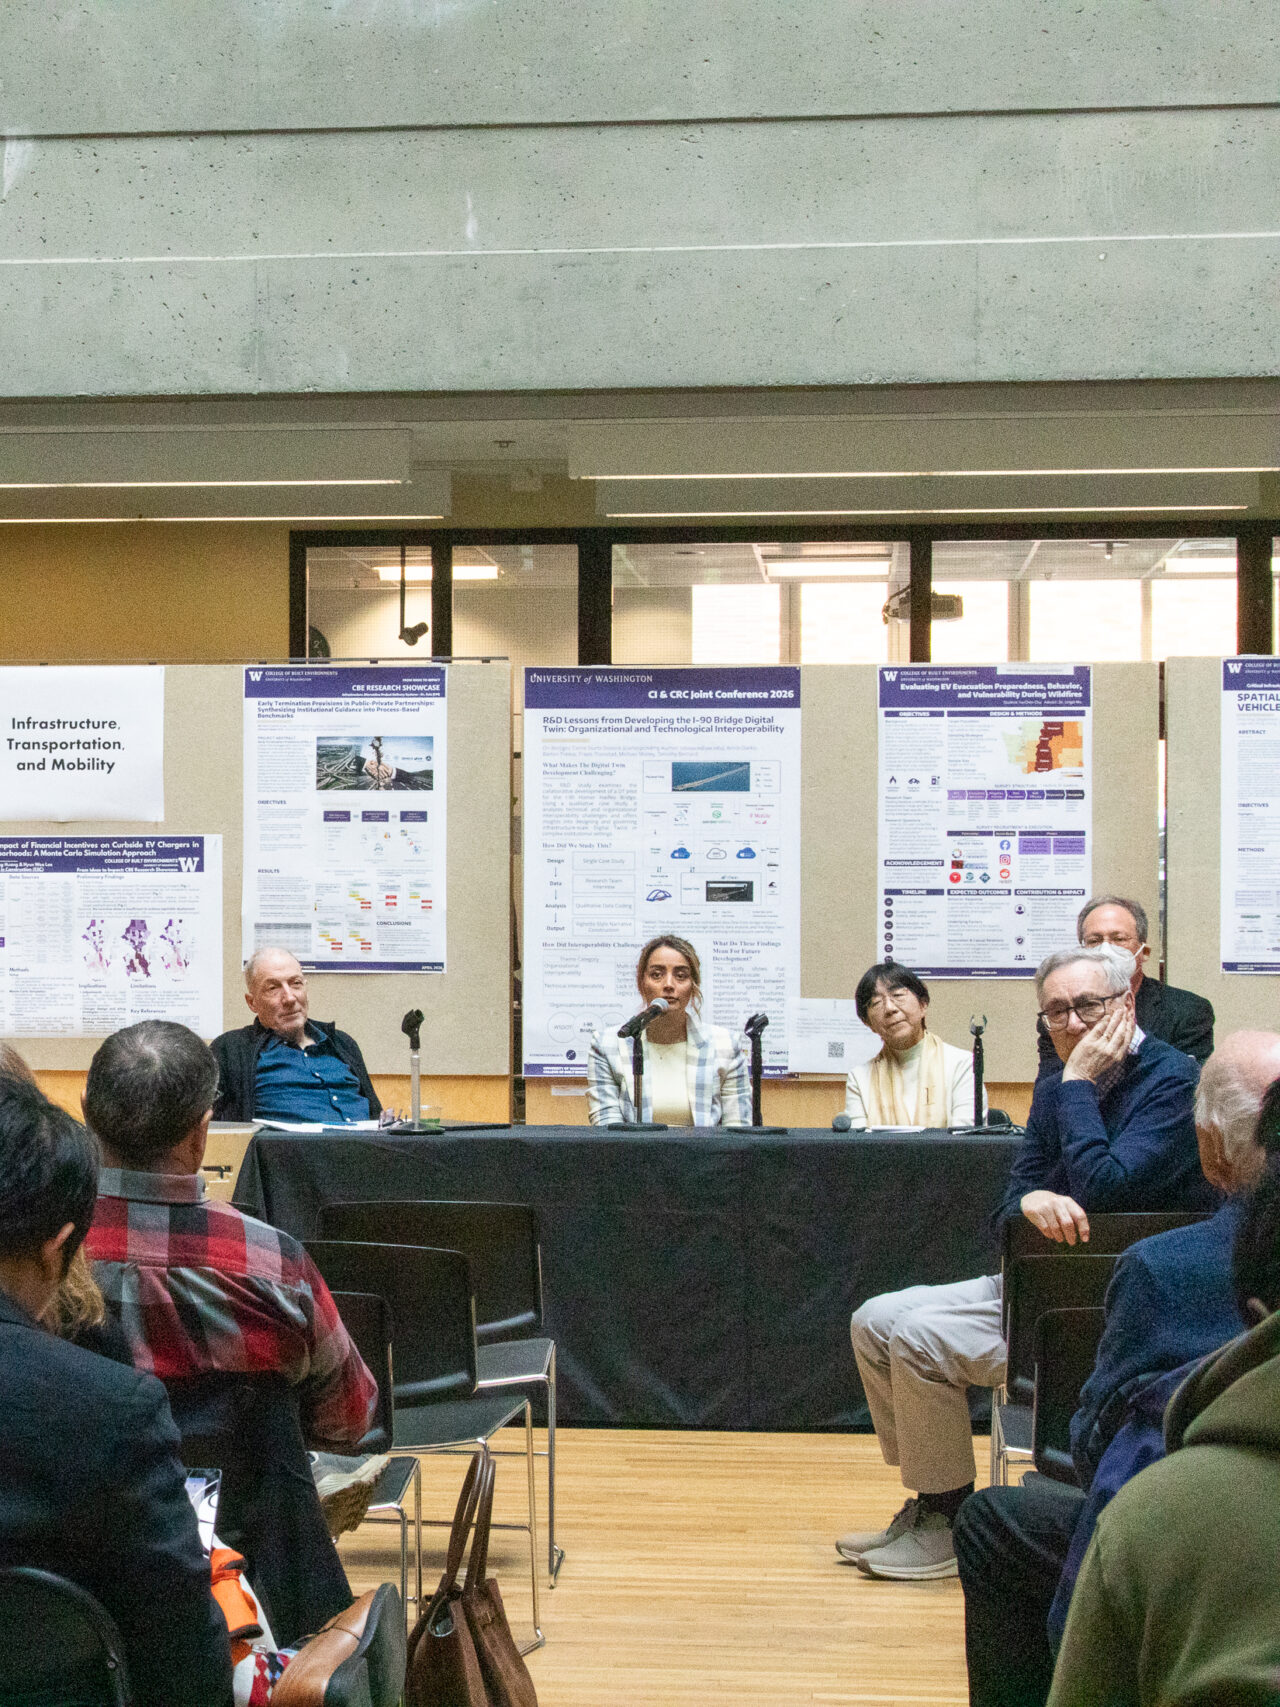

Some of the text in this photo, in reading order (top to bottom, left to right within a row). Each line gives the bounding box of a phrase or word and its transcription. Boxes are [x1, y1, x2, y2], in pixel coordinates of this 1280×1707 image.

[1227, 663, 1242, 673] W
[248, 671, 263, 681] W
[530, 674, 580, 682] UNIVERSITY
[583, 676, 592, 684] of
[883, 671, 898, 681] W
[691, 690, 713, 699] Joint
[715, 690, 768, 698] Conference
[770, 690, 794, 698] 2026
[11, 717, 121, 730] Infrastructure,
[624, 717, 674, 725] Developing
[714, 716, 743, 725] Bridge
[745, 716, 774, 725] Digital
[568, 726, 632, 734] Organizational
[653, 725, 713, 734] Technological
[715, 726, 784, 734] Interoperability
[7, 737, 125, 753] Transportation,
[16, 758, 115, 774] and Mobility
[157, 841, 190, 849] Chargers
[178, 857, 199, 872] W
